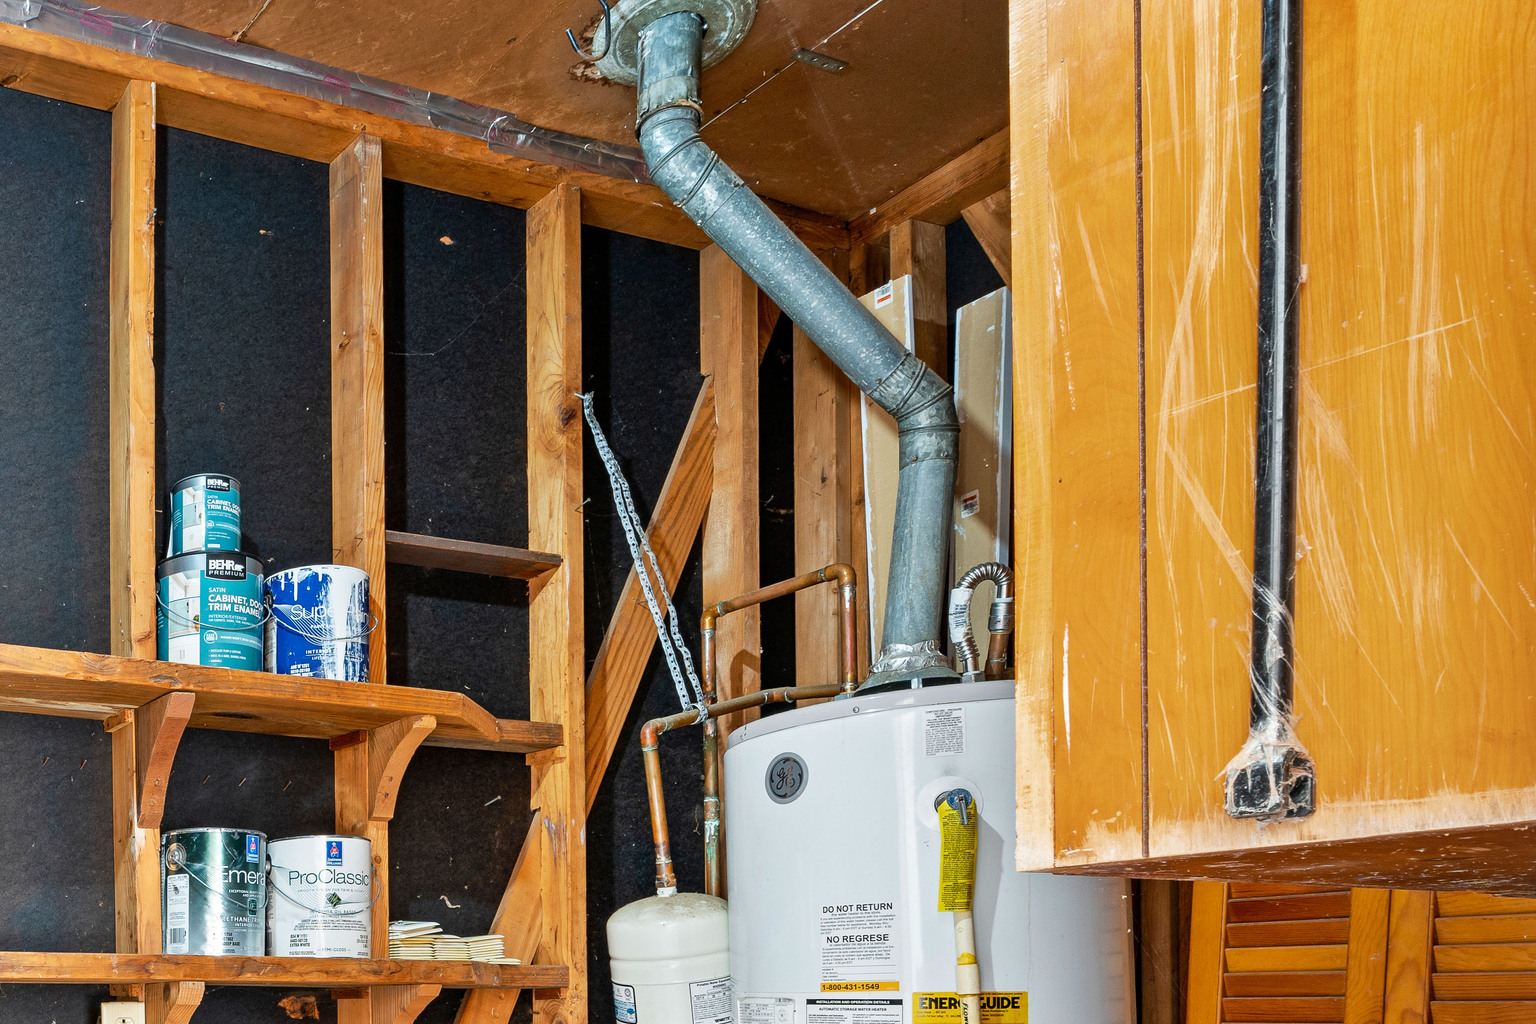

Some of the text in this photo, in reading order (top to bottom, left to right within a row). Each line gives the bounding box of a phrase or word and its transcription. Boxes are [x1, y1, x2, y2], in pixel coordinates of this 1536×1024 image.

[207, 478, 224, 486] BEHR
[207, 499, 231, 507] CABINET,
[208, 560, 234, 571] BEHR
[208, 595, 248, 606] CABINET,
[208, 603, 261, 620] TRIM ENAMEL
[223, 866, 266, 886] Emera
[289, 868, 369, 886] ProClassic
[823, 906, 834, 914] DO
[856, 903, 893, 912] RETURN
[843, 934, 889, 943] REGRESE
